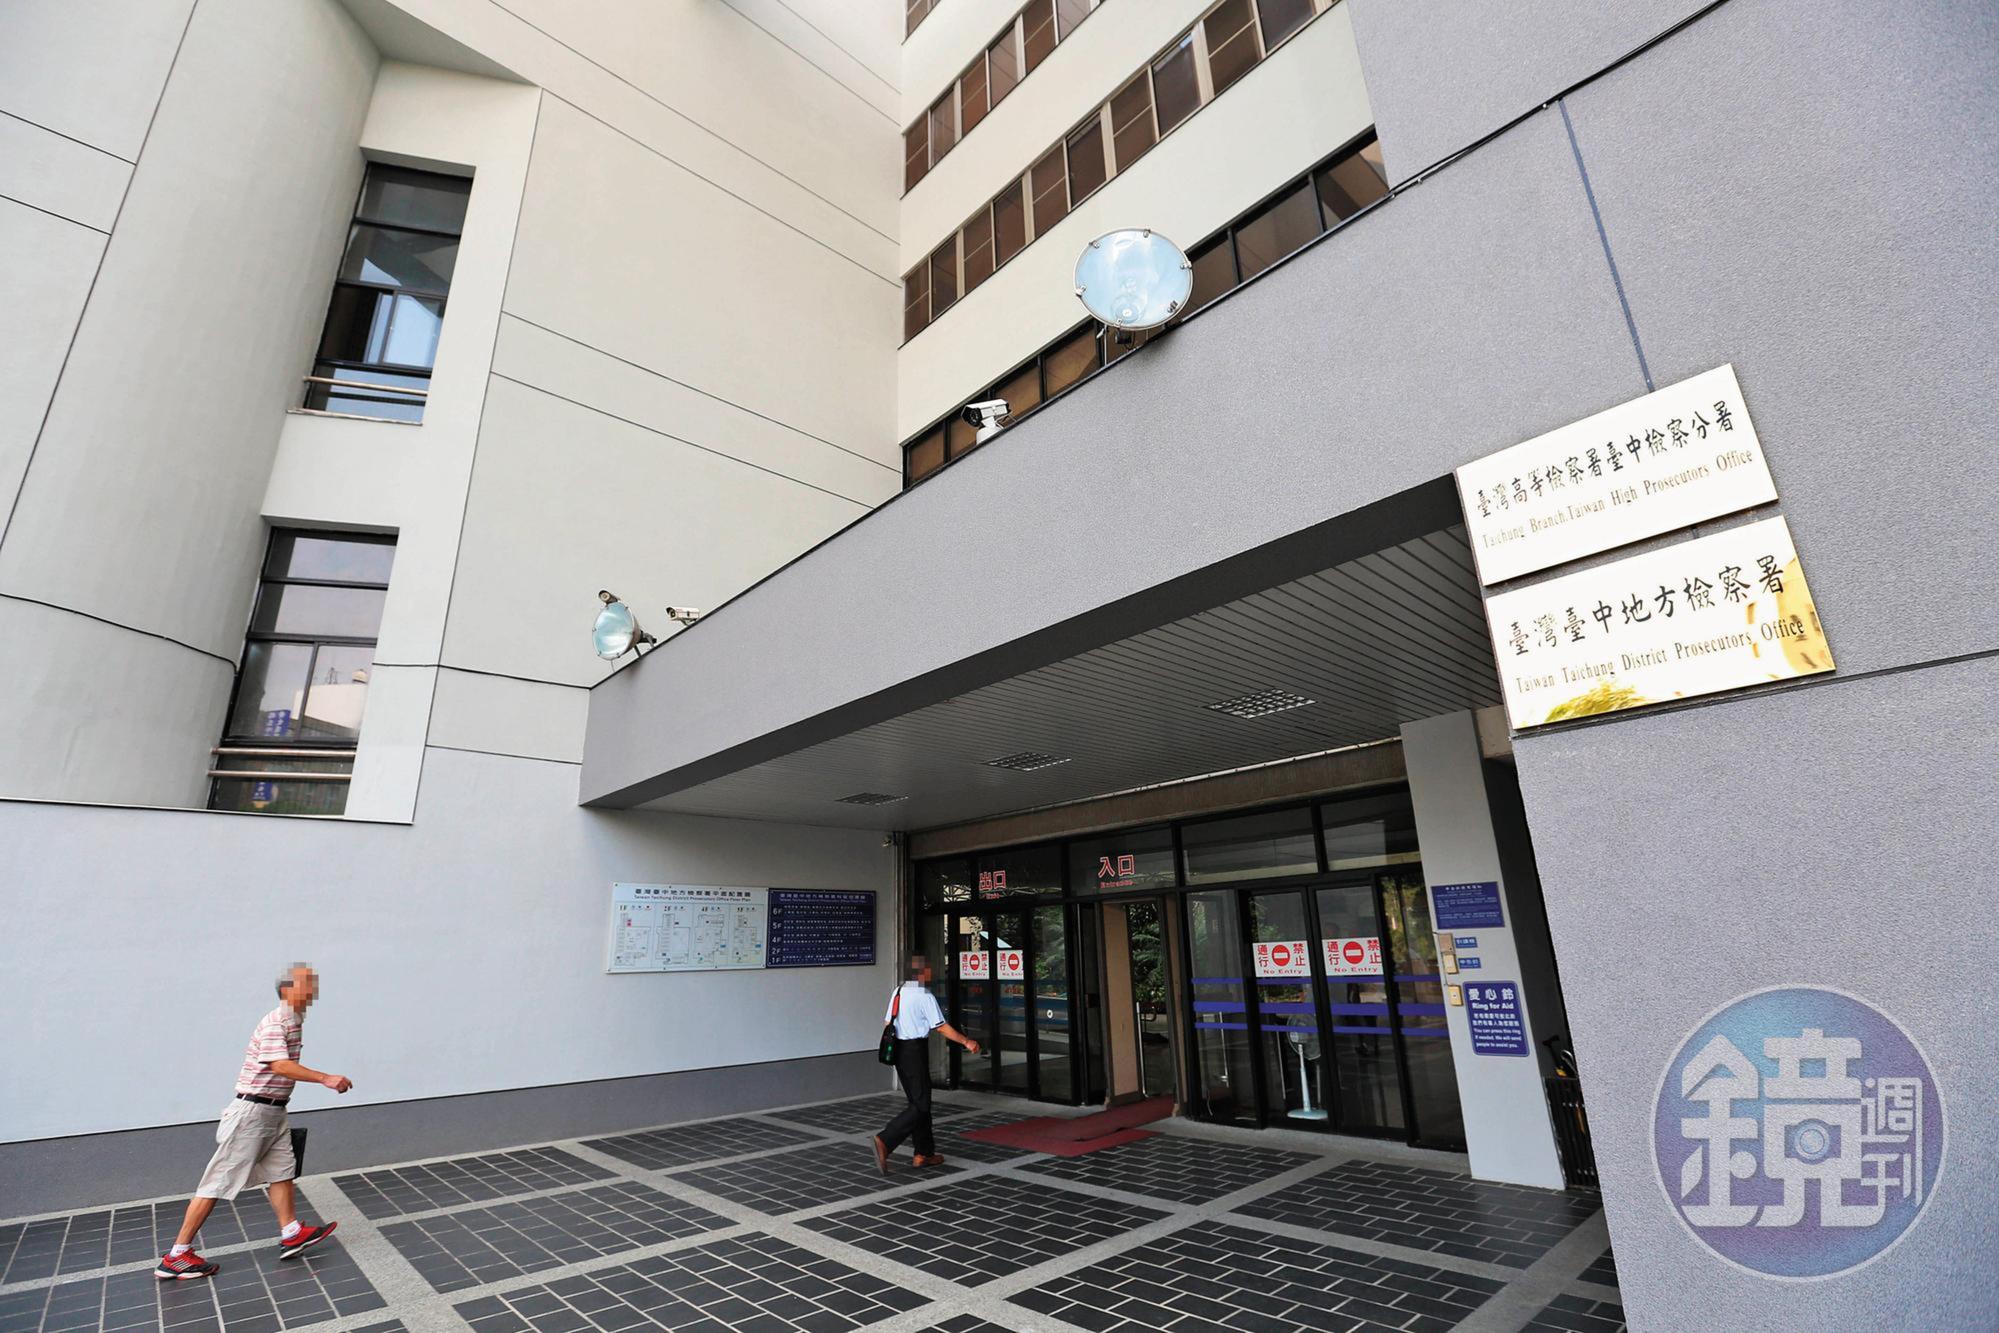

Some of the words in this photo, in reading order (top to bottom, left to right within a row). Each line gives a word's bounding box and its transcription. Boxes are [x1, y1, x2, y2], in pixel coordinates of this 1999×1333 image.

[1477, 400, 1734, 518] 臺灣高等檢察署臺中檢察分署
[1610, 485, 1638, 505] High
[1643, 463, 1710, 496] Prosecutors
[1716, 449, 1753, 472] Office
[1509, 554, 1784, 656] 臺灣臺中地方檢察署
[1516, 675, 1555, 693] Taiwan
[1562, 660, 1616, 683] Taichung
[1621, 649, 1668, 671] District
[1674, 631, 1752, 659] Prosecutors
[1760, 618, 1805, 641] Office
[979, 870, 1007, 891] 出口
[1098, 854, 1135, 877] 入口
[1469, 988, 1514, 1001] 愛心鈴
[1472, 1002, 1489, 1010] Ring
[1502, 1002, 1514, 1010] Aid
